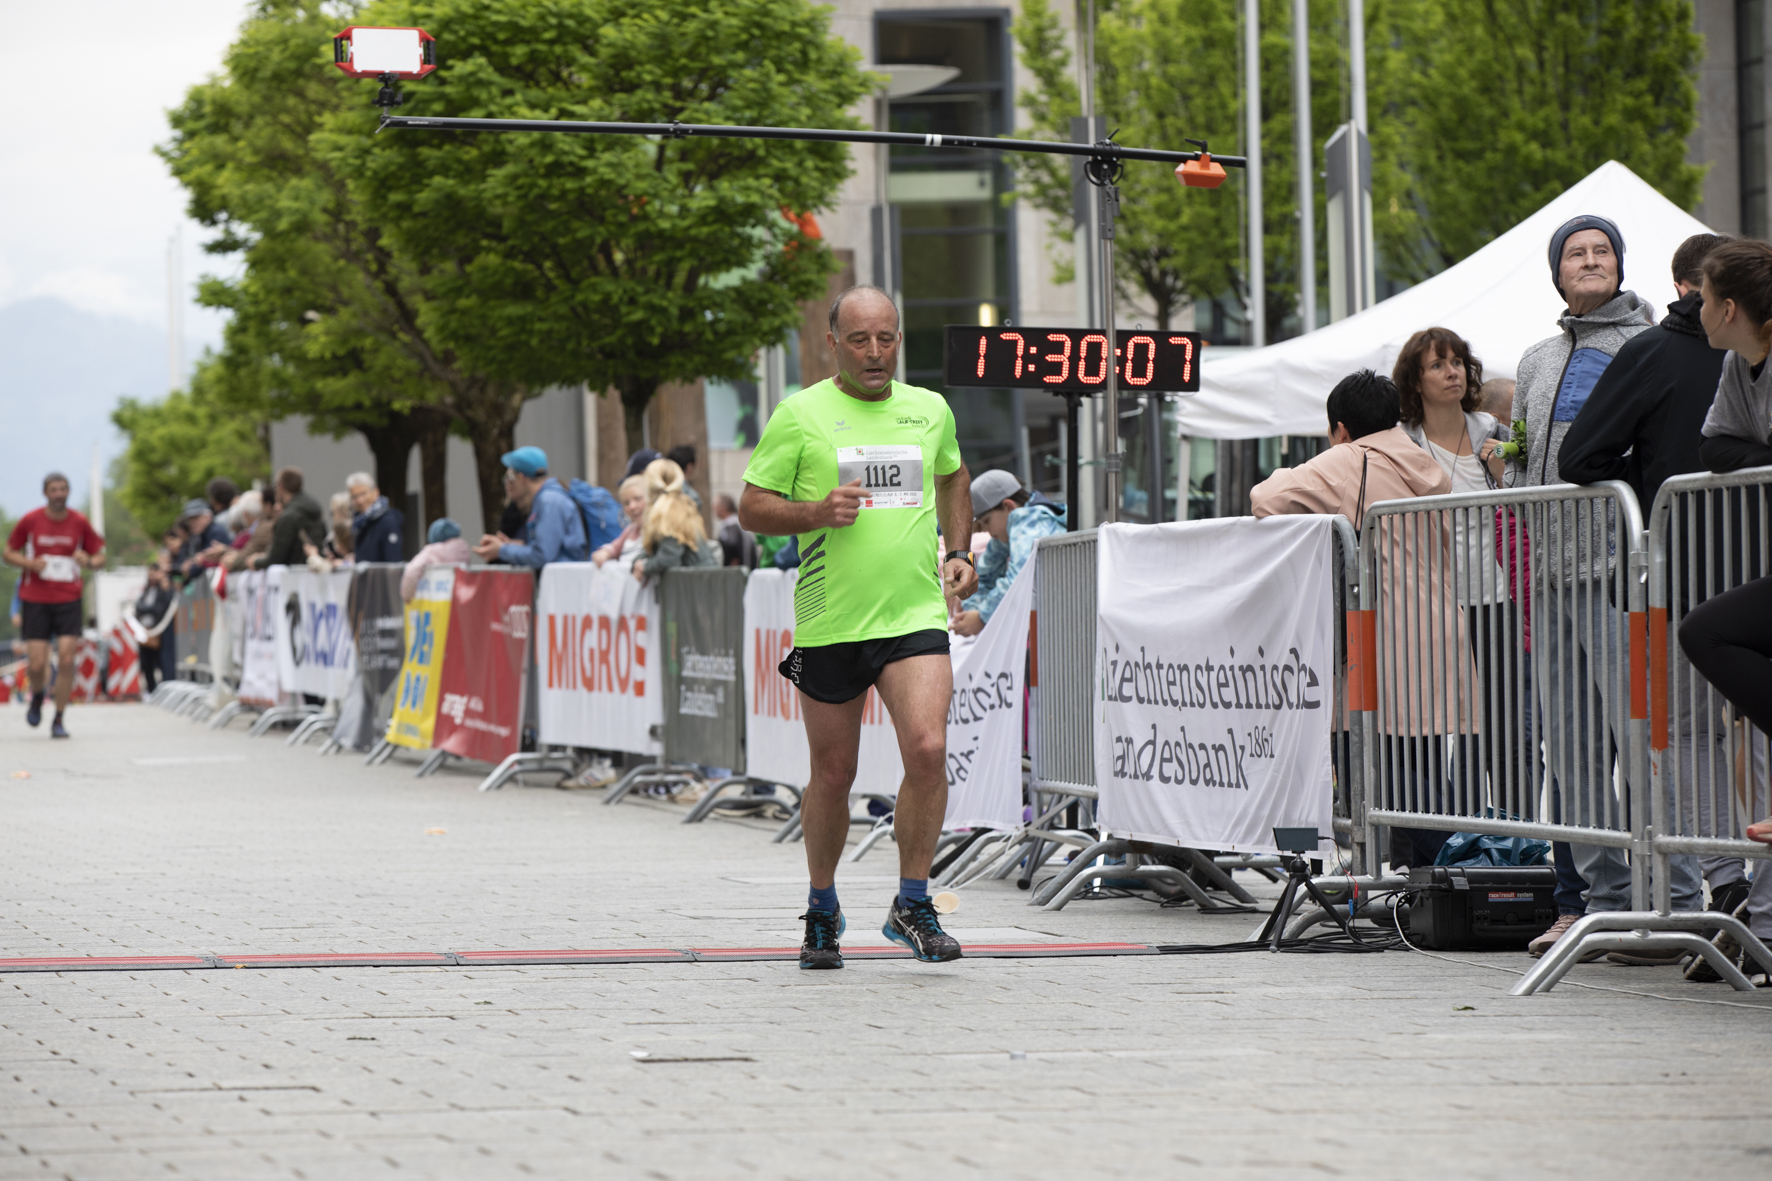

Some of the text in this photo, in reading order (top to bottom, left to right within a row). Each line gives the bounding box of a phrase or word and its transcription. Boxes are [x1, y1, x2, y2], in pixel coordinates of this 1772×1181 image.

[865, 464, 901, 487] 1112
[547, 613, 648, 698] MIGROS
[754, 628, 803, 721] MIG
[1247, 725, 1275, 759] 1861
